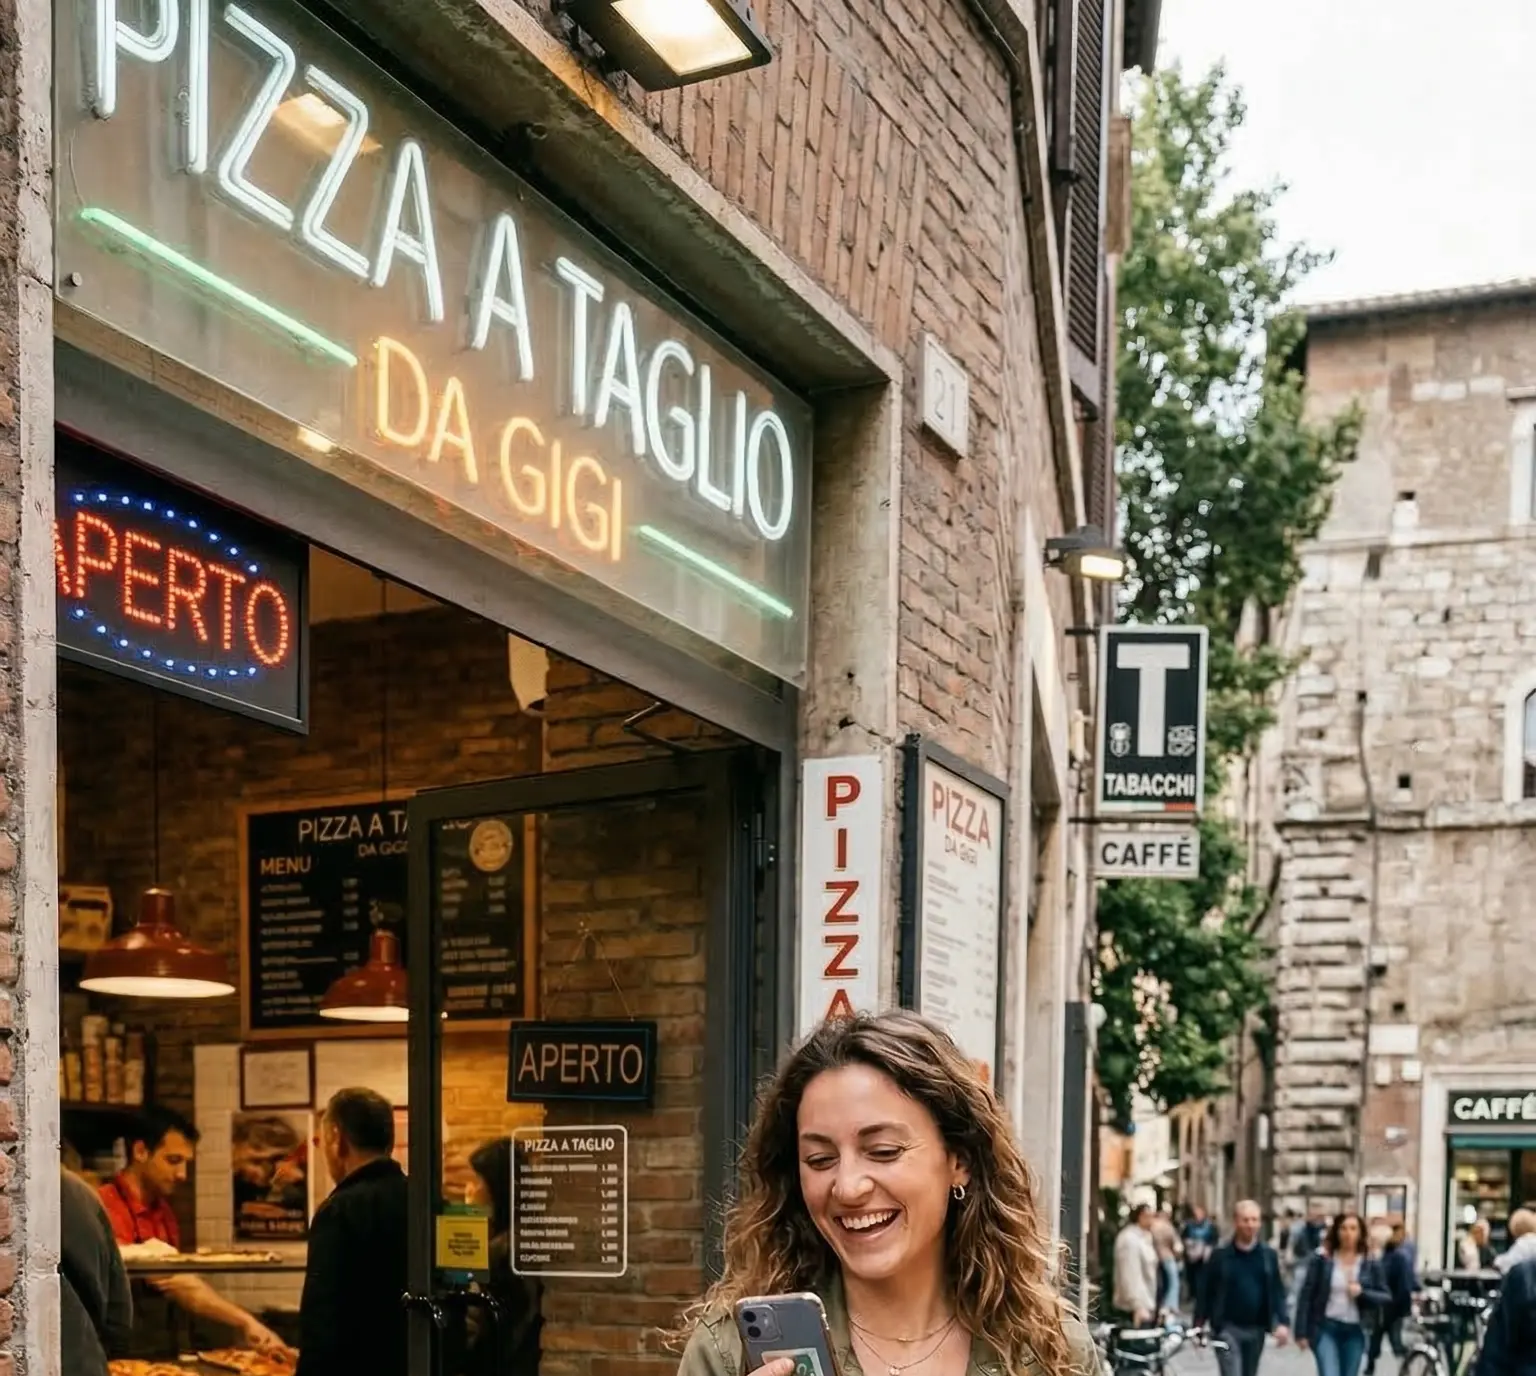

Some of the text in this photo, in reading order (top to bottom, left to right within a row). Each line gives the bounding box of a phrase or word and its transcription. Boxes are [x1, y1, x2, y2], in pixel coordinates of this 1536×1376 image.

[95, 0, 794, 541] PIZZA A TAGLIO
[934, 366, 956, 435] 21
[374, 334, 623, 562] DA GIGI
[1116, 643, 1191, 758] T
[932, 779, 992, 852] PIZZA
[1104, 772, 1196, 797] TABACCHI
[298, 814, 364, 844] PIZZA
[367, 812, 385, 838] A
[260, 856, 312, 876] MENU
[823, 774, 861, 1023] PIZZA
[518, 1042, 643, 1084] APERTO
[524, 1137, 616, 1153] PIZZA A TAGLIO
